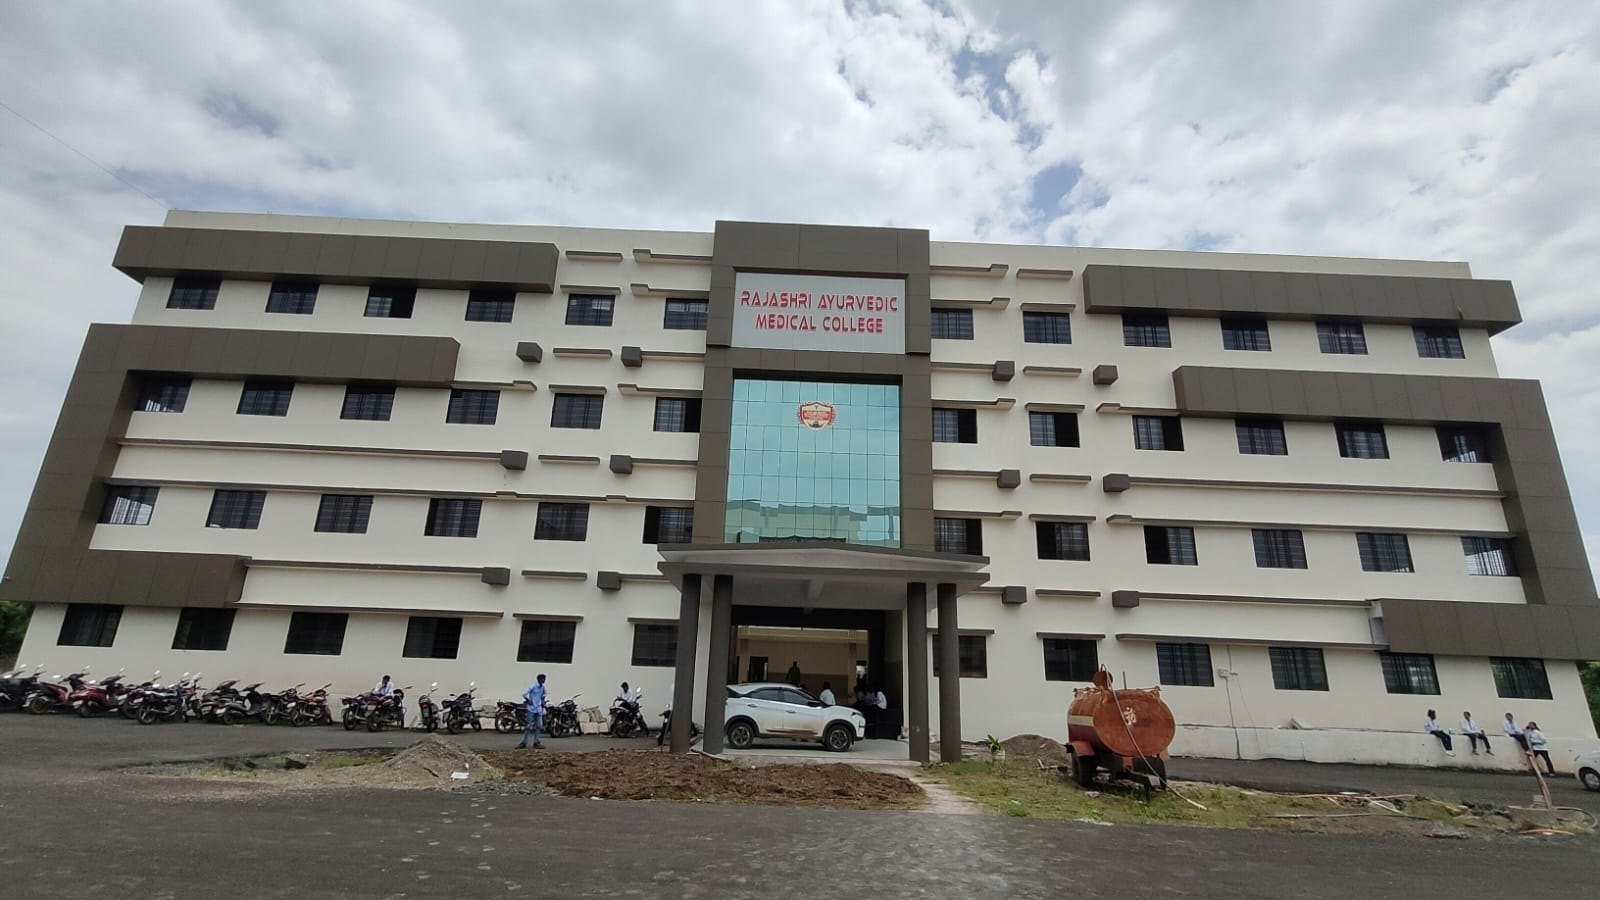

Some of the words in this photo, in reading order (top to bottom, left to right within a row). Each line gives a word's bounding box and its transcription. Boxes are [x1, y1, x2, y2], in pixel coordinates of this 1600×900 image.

[740, 290, 811, 309] RAJASHRI
[817, 294, 898, 312] AYURVEDIC
[755, 313, 817, 331] MEDICAL
[822, 316, 883, 333] COLLEGE
